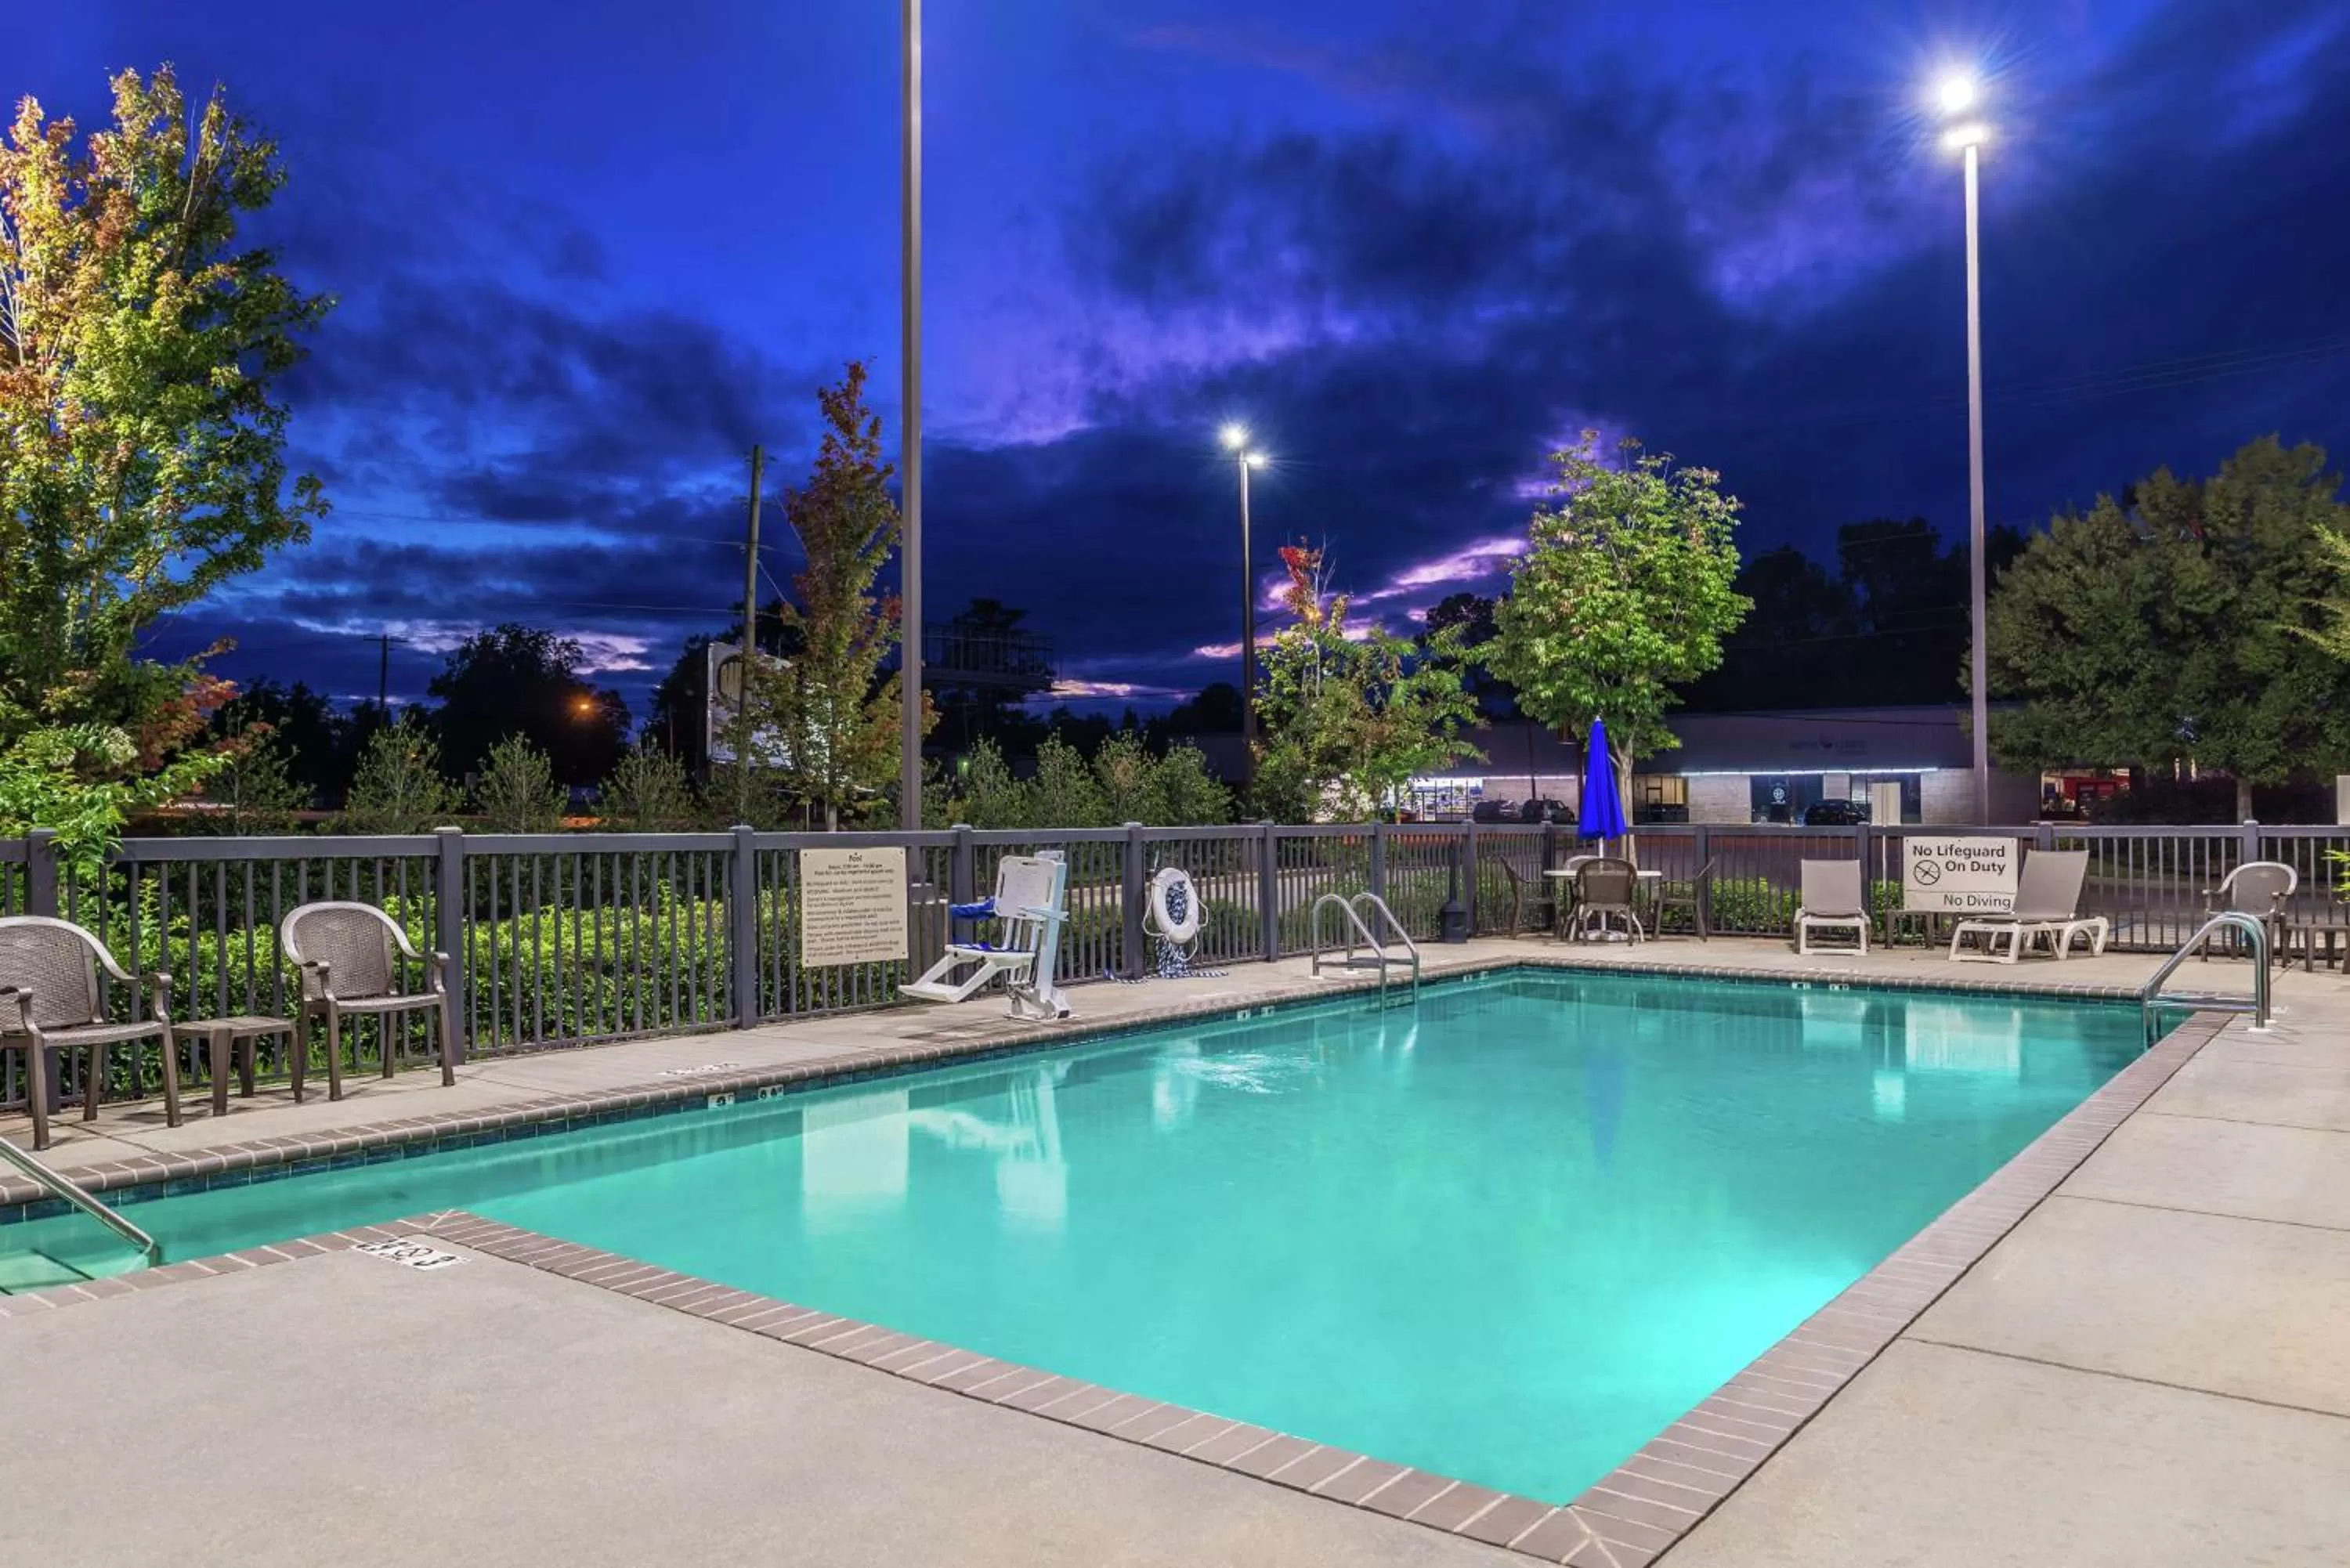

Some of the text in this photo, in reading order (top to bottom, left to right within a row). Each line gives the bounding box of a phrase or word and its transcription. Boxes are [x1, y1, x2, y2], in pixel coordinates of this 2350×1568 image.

[1913, 844, 2005, 859] No Lifeguard
[1945, 860, 2006, 876] On Duty
[1943, 894, 2011, 910] No Diving
